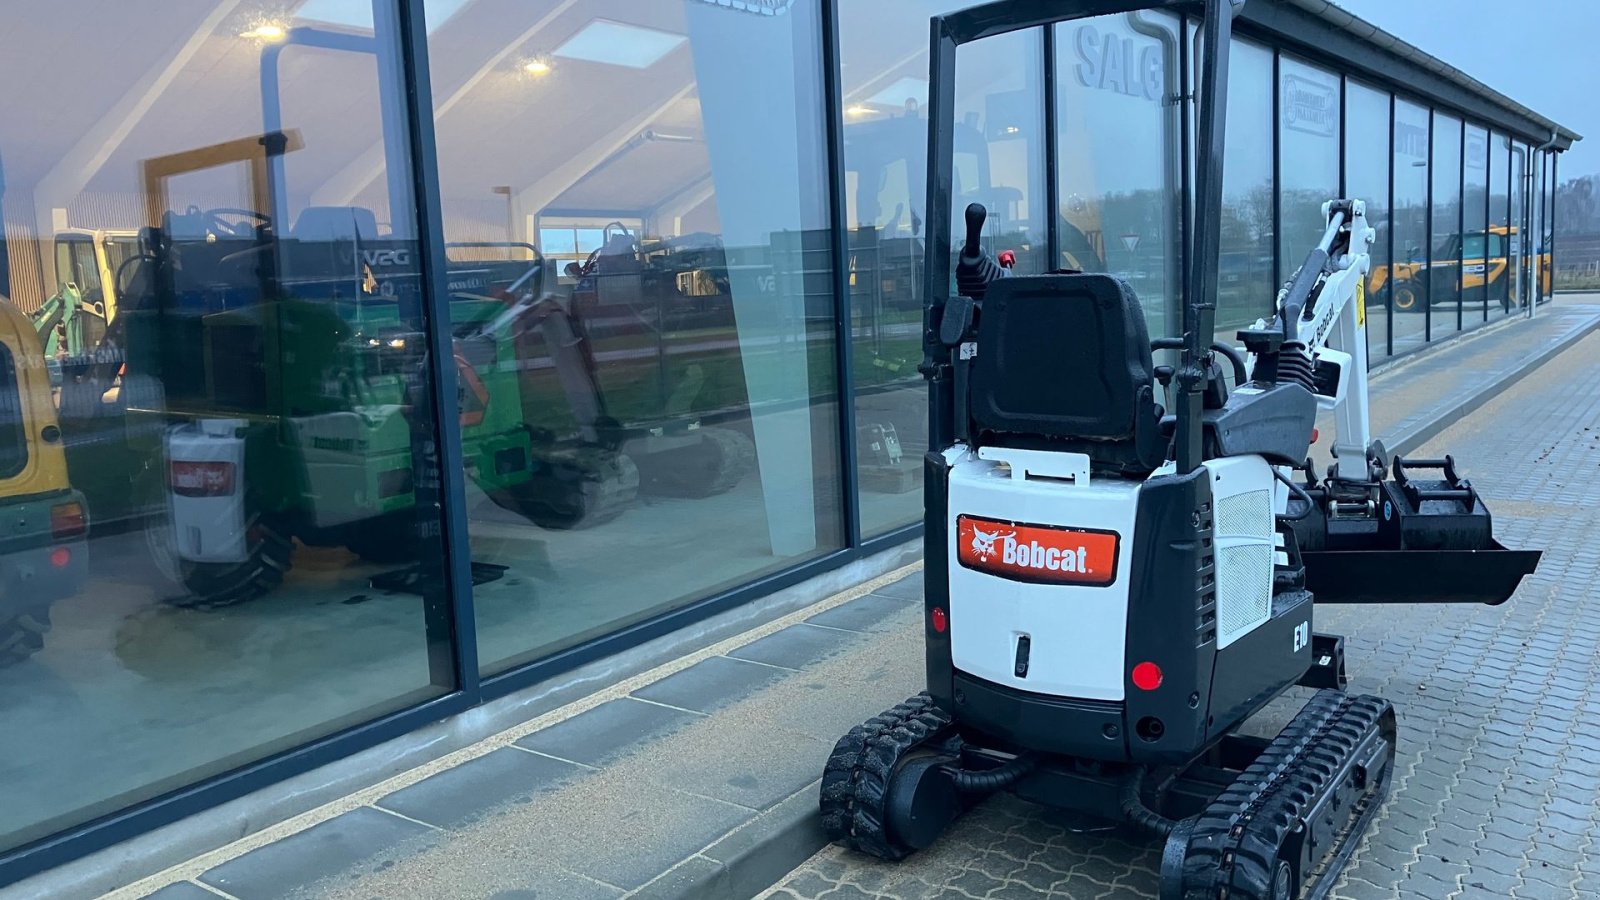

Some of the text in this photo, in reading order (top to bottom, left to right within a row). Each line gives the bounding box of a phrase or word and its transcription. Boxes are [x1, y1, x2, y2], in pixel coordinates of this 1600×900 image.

[1075, 25, 1163, 100] SALG
[1002, 536, 1087, 574] Bobcat
[1294, 620, 1309, 653] E10
